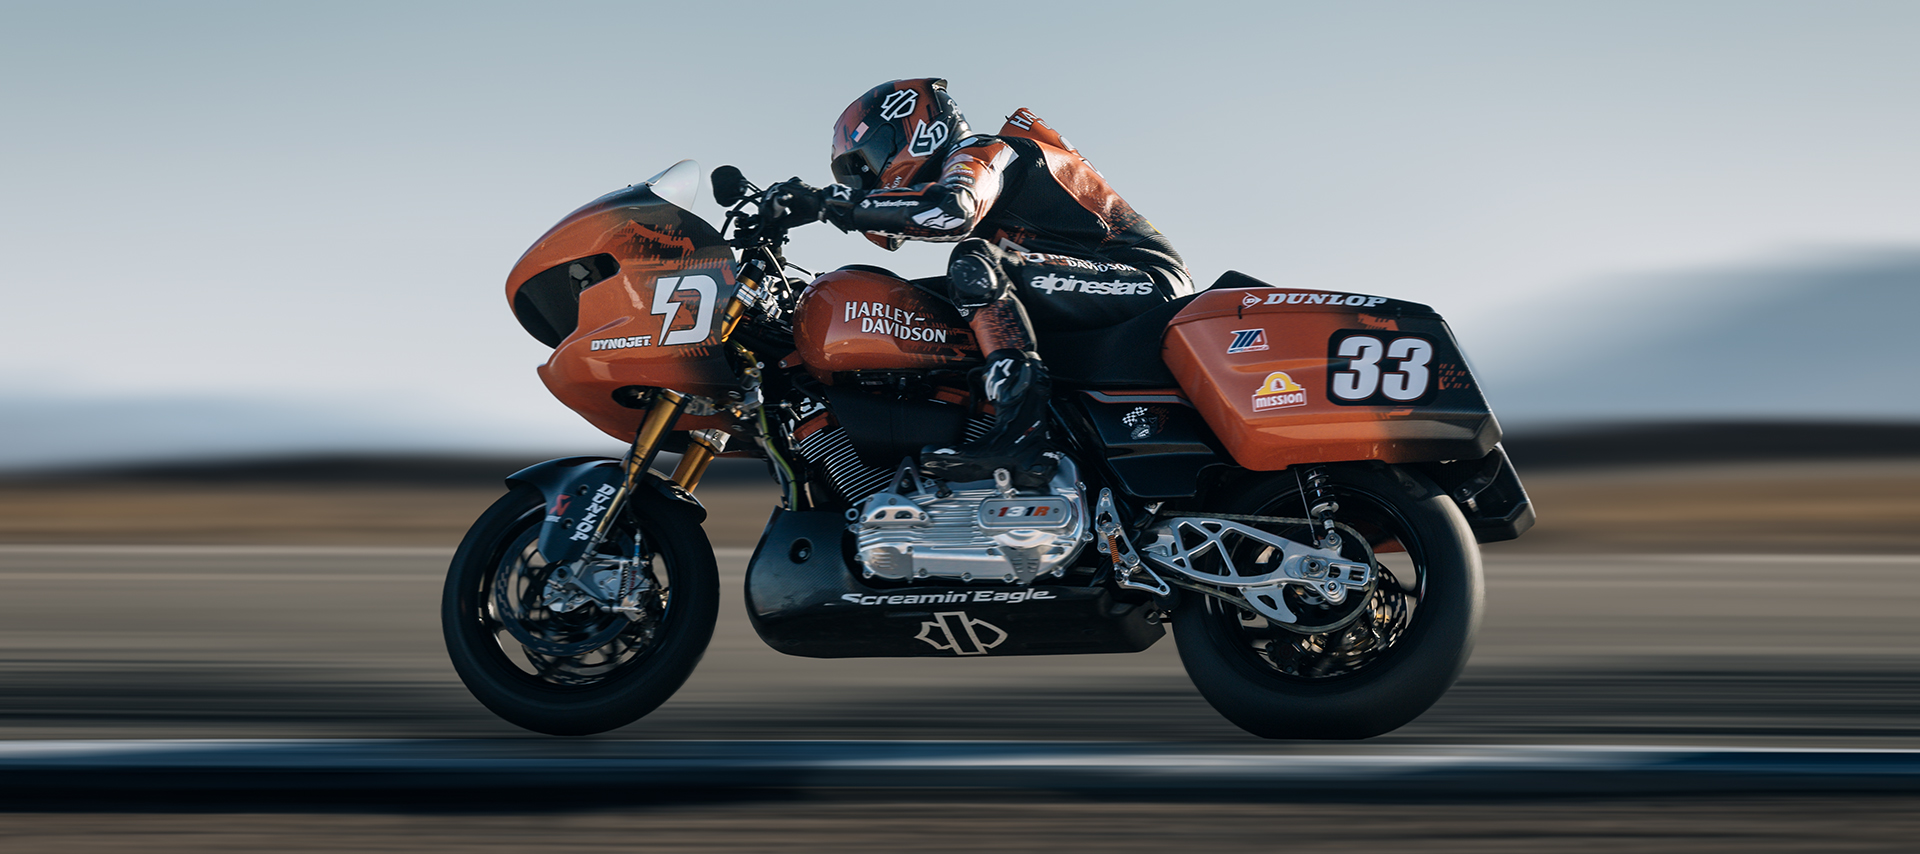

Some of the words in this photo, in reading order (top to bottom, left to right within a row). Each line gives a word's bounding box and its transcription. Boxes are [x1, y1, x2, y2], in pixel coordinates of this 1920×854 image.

[1030, 273, 1153, 295] alpinestars
[1263, 293, 1388, 308] DUNLOP
[844, 301, 926, 326] HARLEY-
[861, 317, 947, 343] DAVIDSON
[591, 335, 652, 351] DYNOJET
[1333, 336, 1432, 400] 33
[569, 483, 616, 541] DUNLOP
[997, 506, 1050, 517] 131R
[841, 590, 972, 606] Screamin'
[972, 588, 1058, 604] Eagle
